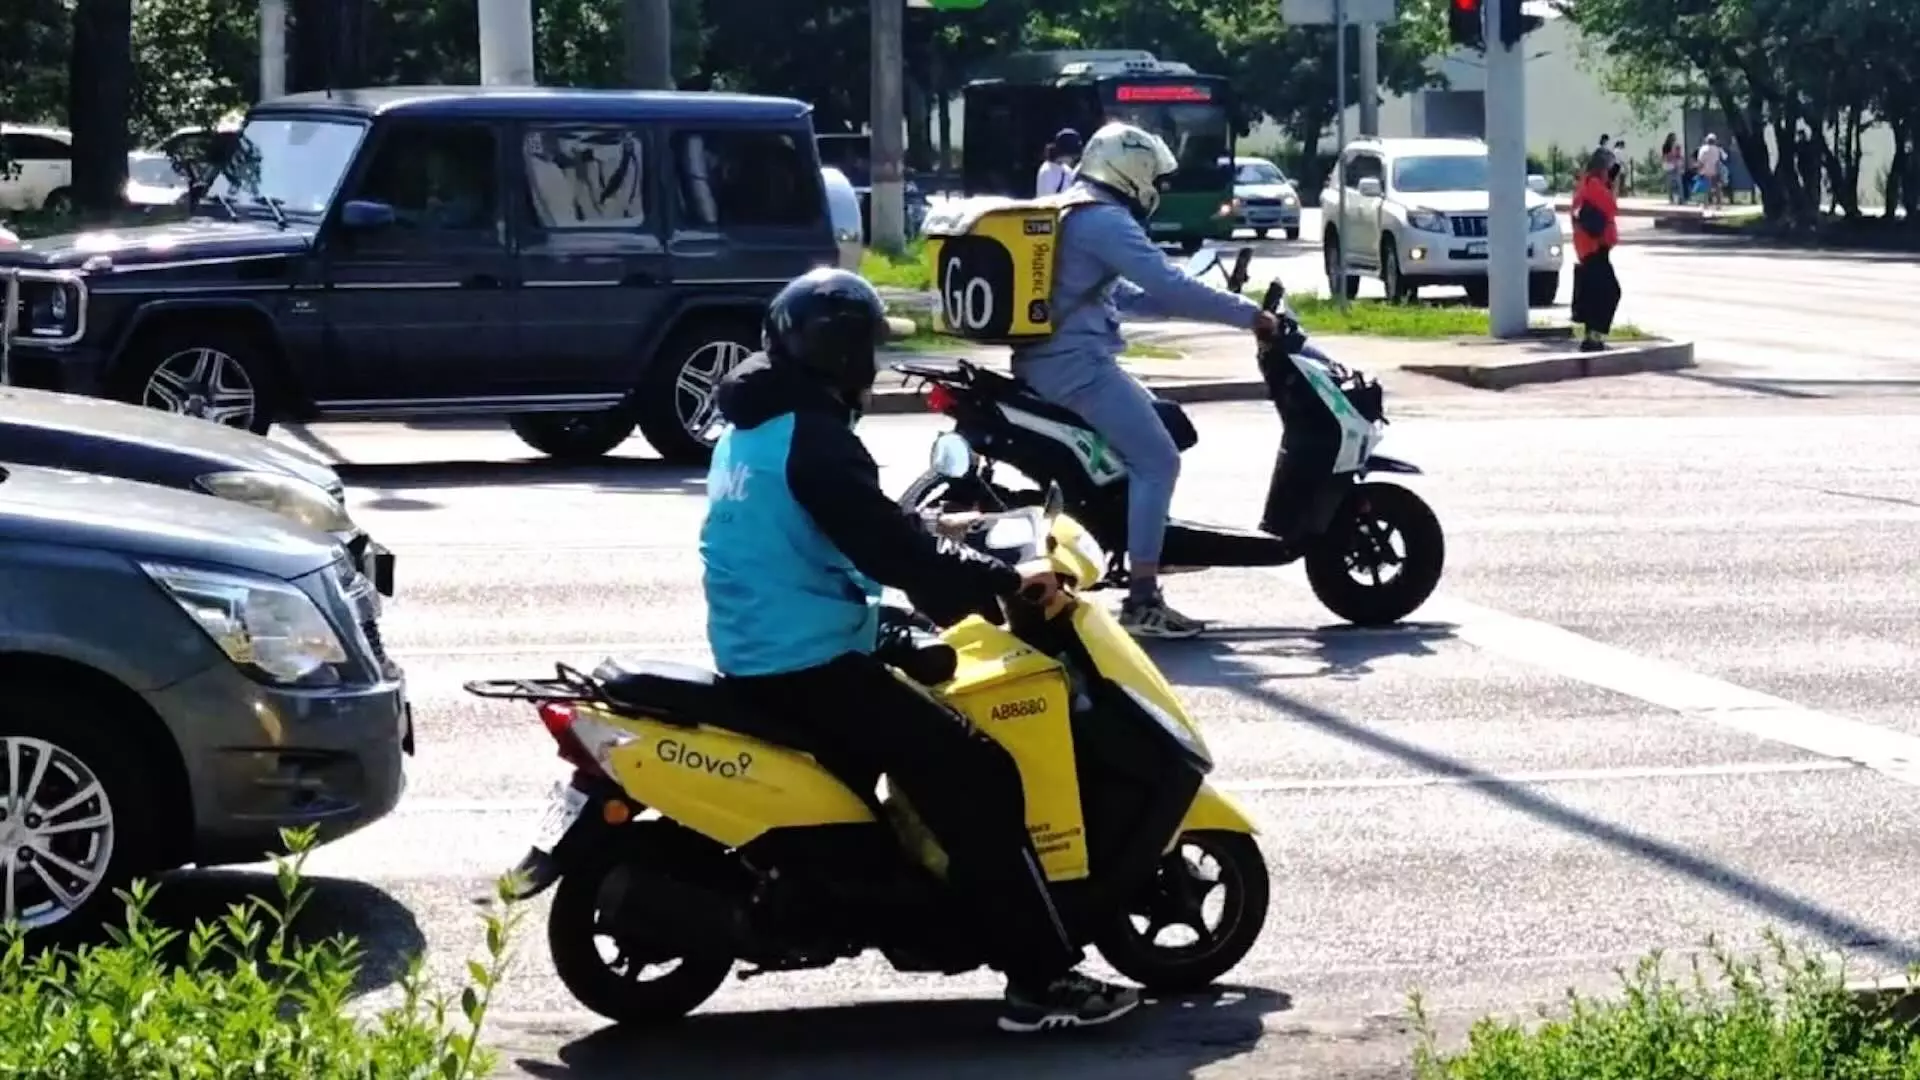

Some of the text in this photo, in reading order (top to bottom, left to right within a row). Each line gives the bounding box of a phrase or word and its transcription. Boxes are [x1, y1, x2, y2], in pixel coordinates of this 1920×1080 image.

[945, 256, 994, 330] Go
[1031, 242, 1050, 295] Яндекс
[656, 739, 737, 778] Glovo
